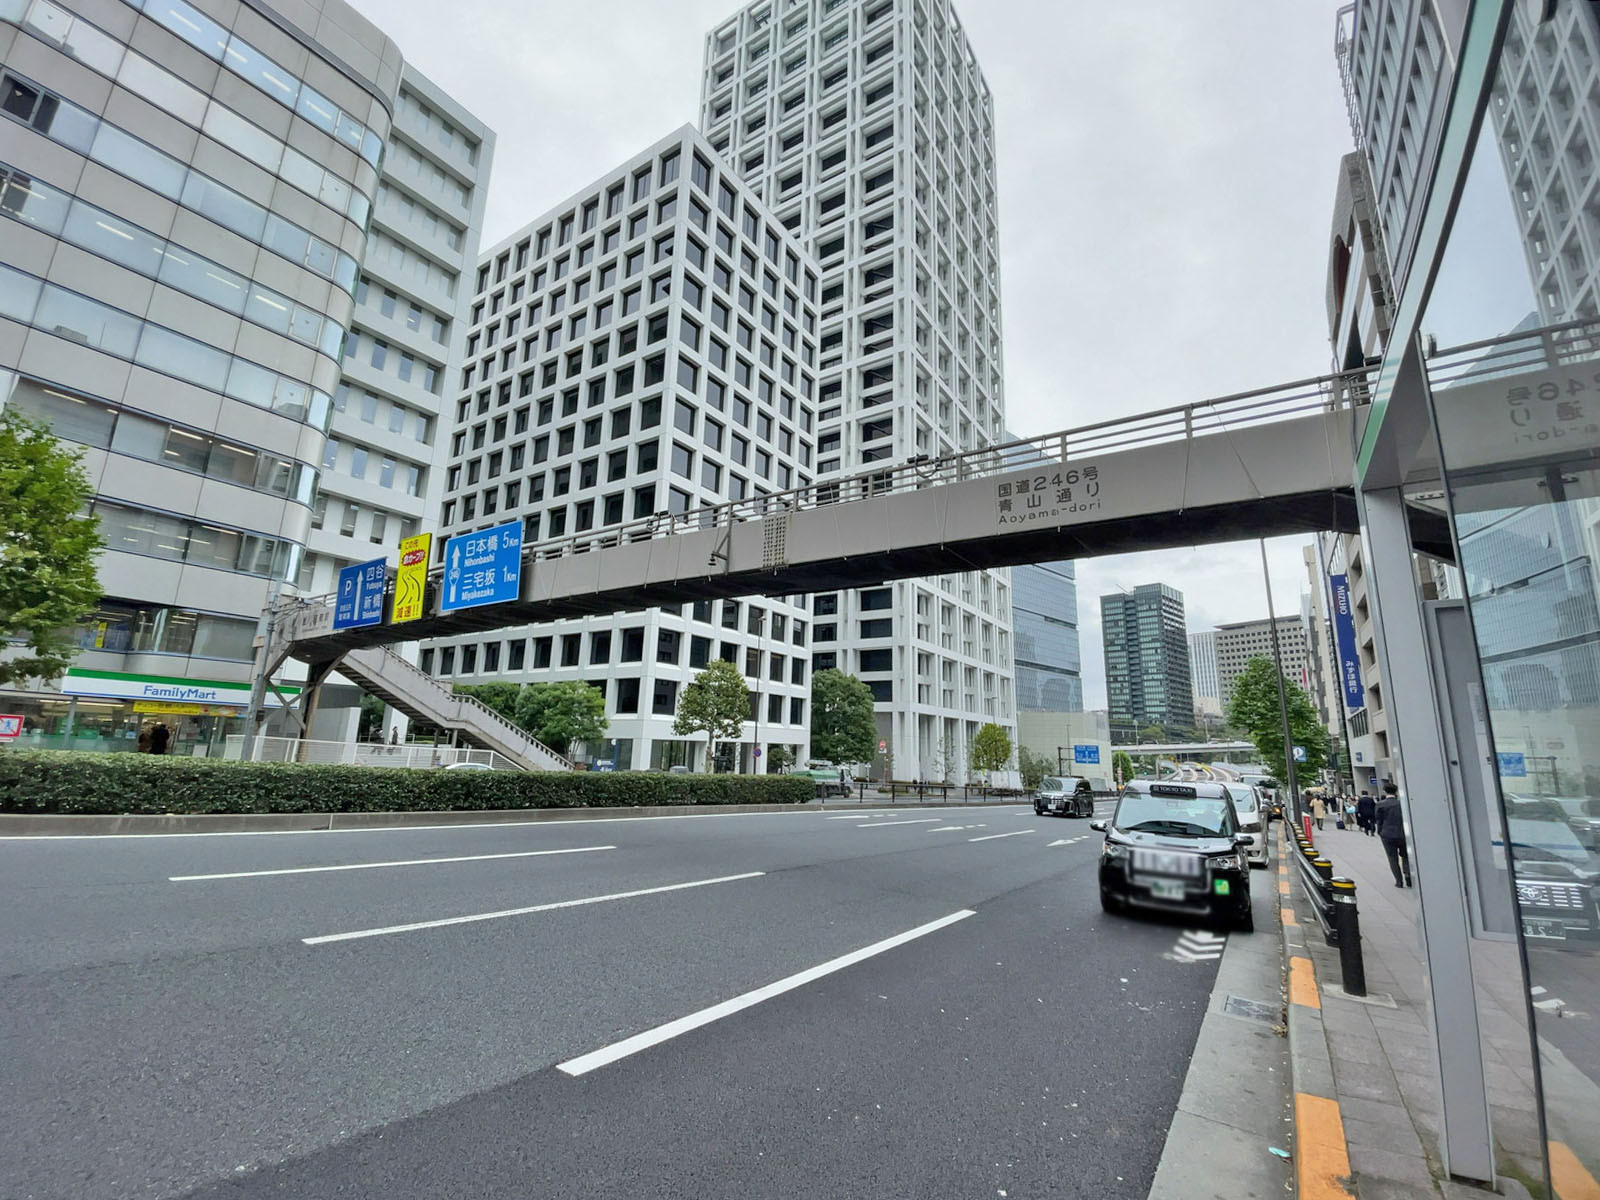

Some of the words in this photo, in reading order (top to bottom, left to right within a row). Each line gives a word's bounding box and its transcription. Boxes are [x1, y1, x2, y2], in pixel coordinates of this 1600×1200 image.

[998, 466, 1099, 498] 国道246号
[998, 481, 1099, 513] 青山通り
[998, 499, 1101, 525] Aoyama-dori
[465, 535, 498, 558] 日本橋
[366, 563, 384, 581] 四谷
[461, 568, 496, 591] 三宅坂
[344, 580, 352, 596] P
[1336, 585, 1348, 615] MIZUHO
[143, 685, 216, 700] FamilyMart
